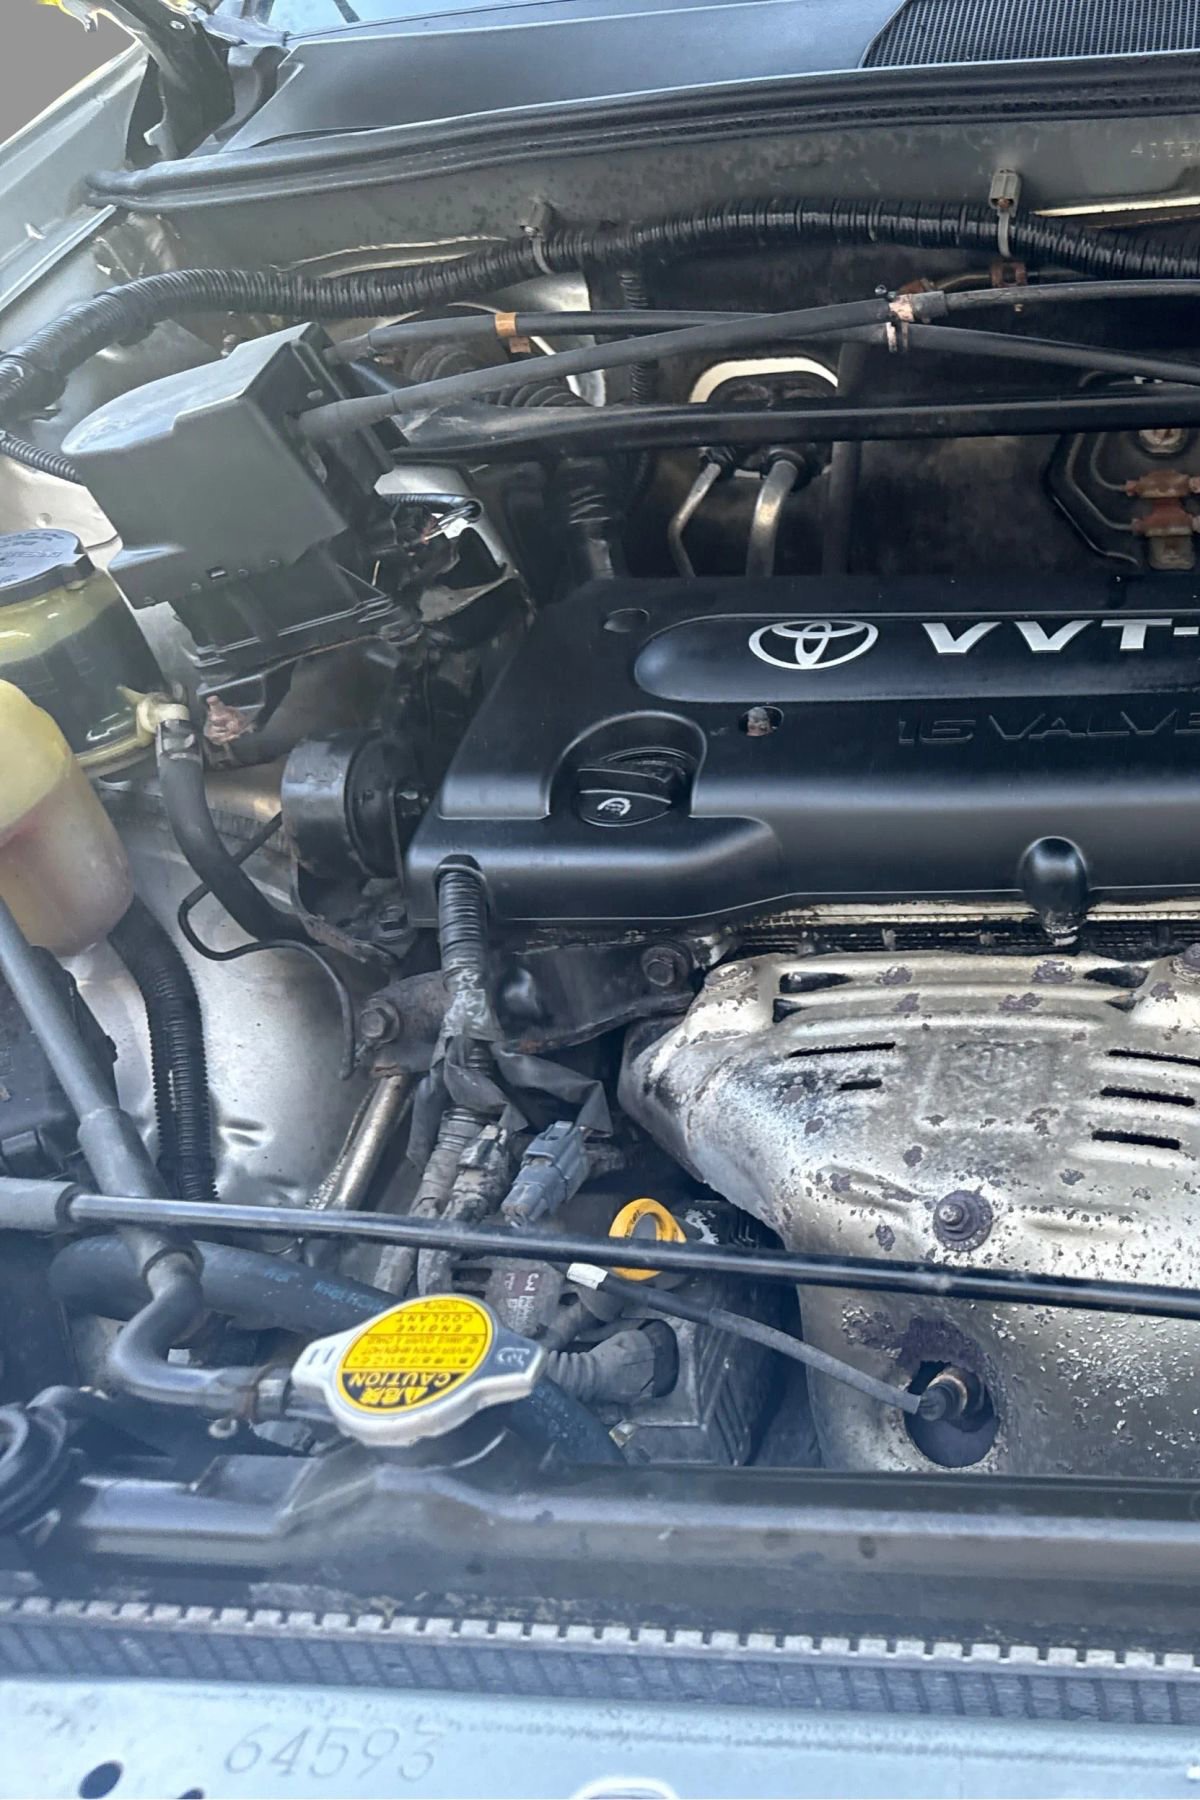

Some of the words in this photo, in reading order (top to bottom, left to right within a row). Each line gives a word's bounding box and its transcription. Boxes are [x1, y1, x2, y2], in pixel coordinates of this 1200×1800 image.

[899, 718, 976, 744] 16
[395, 1313, 474, 1323] COOLANT
[395, 1324, 463, 1333] ENGINE
[440, 1346, 475, 1355] NEVER
[347, 1372, 452, 1387] CAUTION
[223, 1714, 446, 1783] 64593
